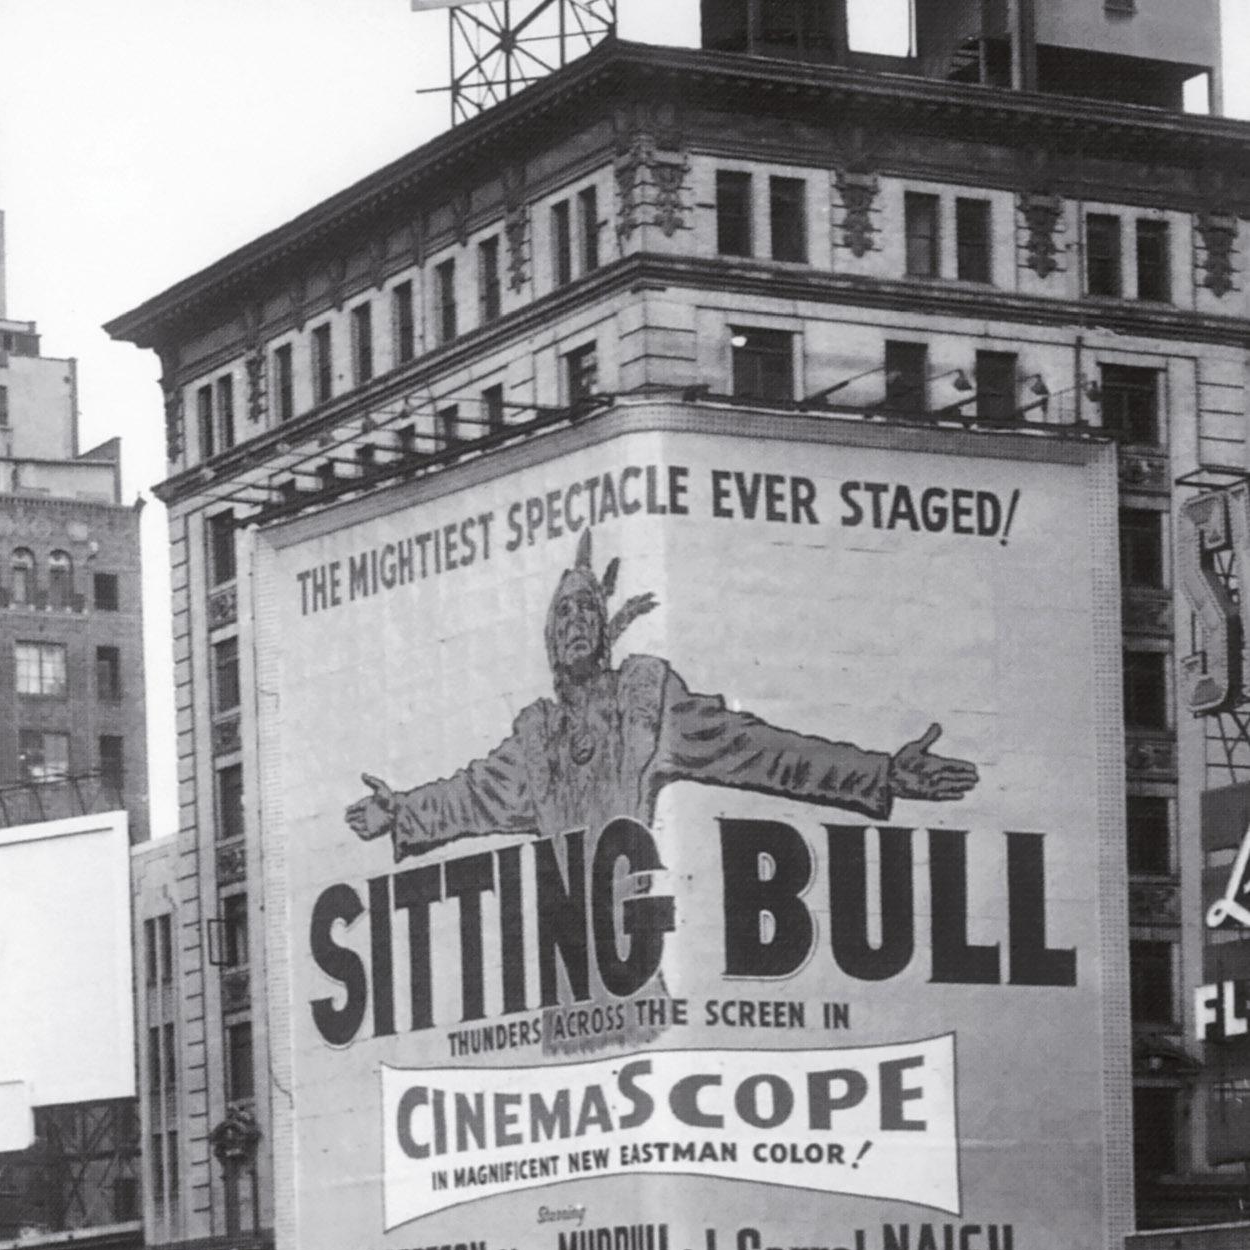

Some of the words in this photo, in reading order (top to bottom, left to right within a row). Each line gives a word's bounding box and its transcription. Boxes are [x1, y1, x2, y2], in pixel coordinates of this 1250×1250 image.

[297, 561, 342, 616] THE
[349, 512, 494, 602] MIGHTIEST
[506, 465, 690, 552] SPECTACLE
[711, 469, 820, 525] EVER
[840, 480, 1021, 547] STAGED!
[308, 816, 676, 1047] SITTING
[717, 816, 1077, 986] BULL
[448, 1017, 542, 1058] THUNDERS
[553, 1003, 625, 1039] ACROSS
[636, 999, 688, 1027] THE
[705, 1000, 806, 1029] SCREEN
[824, 1002, 850, 1029] IN
[432, 1170, 448, 1191] IN
[454, 1155, 559, 1188] MAGNIFICENT
[569, 1149, 609, 1174] NEW
[620, 1141, 737, 1165] EASTMAN
[754, 1141, 873, 1170] COLOR!
[537, 1205, 586, 1226] Starring
